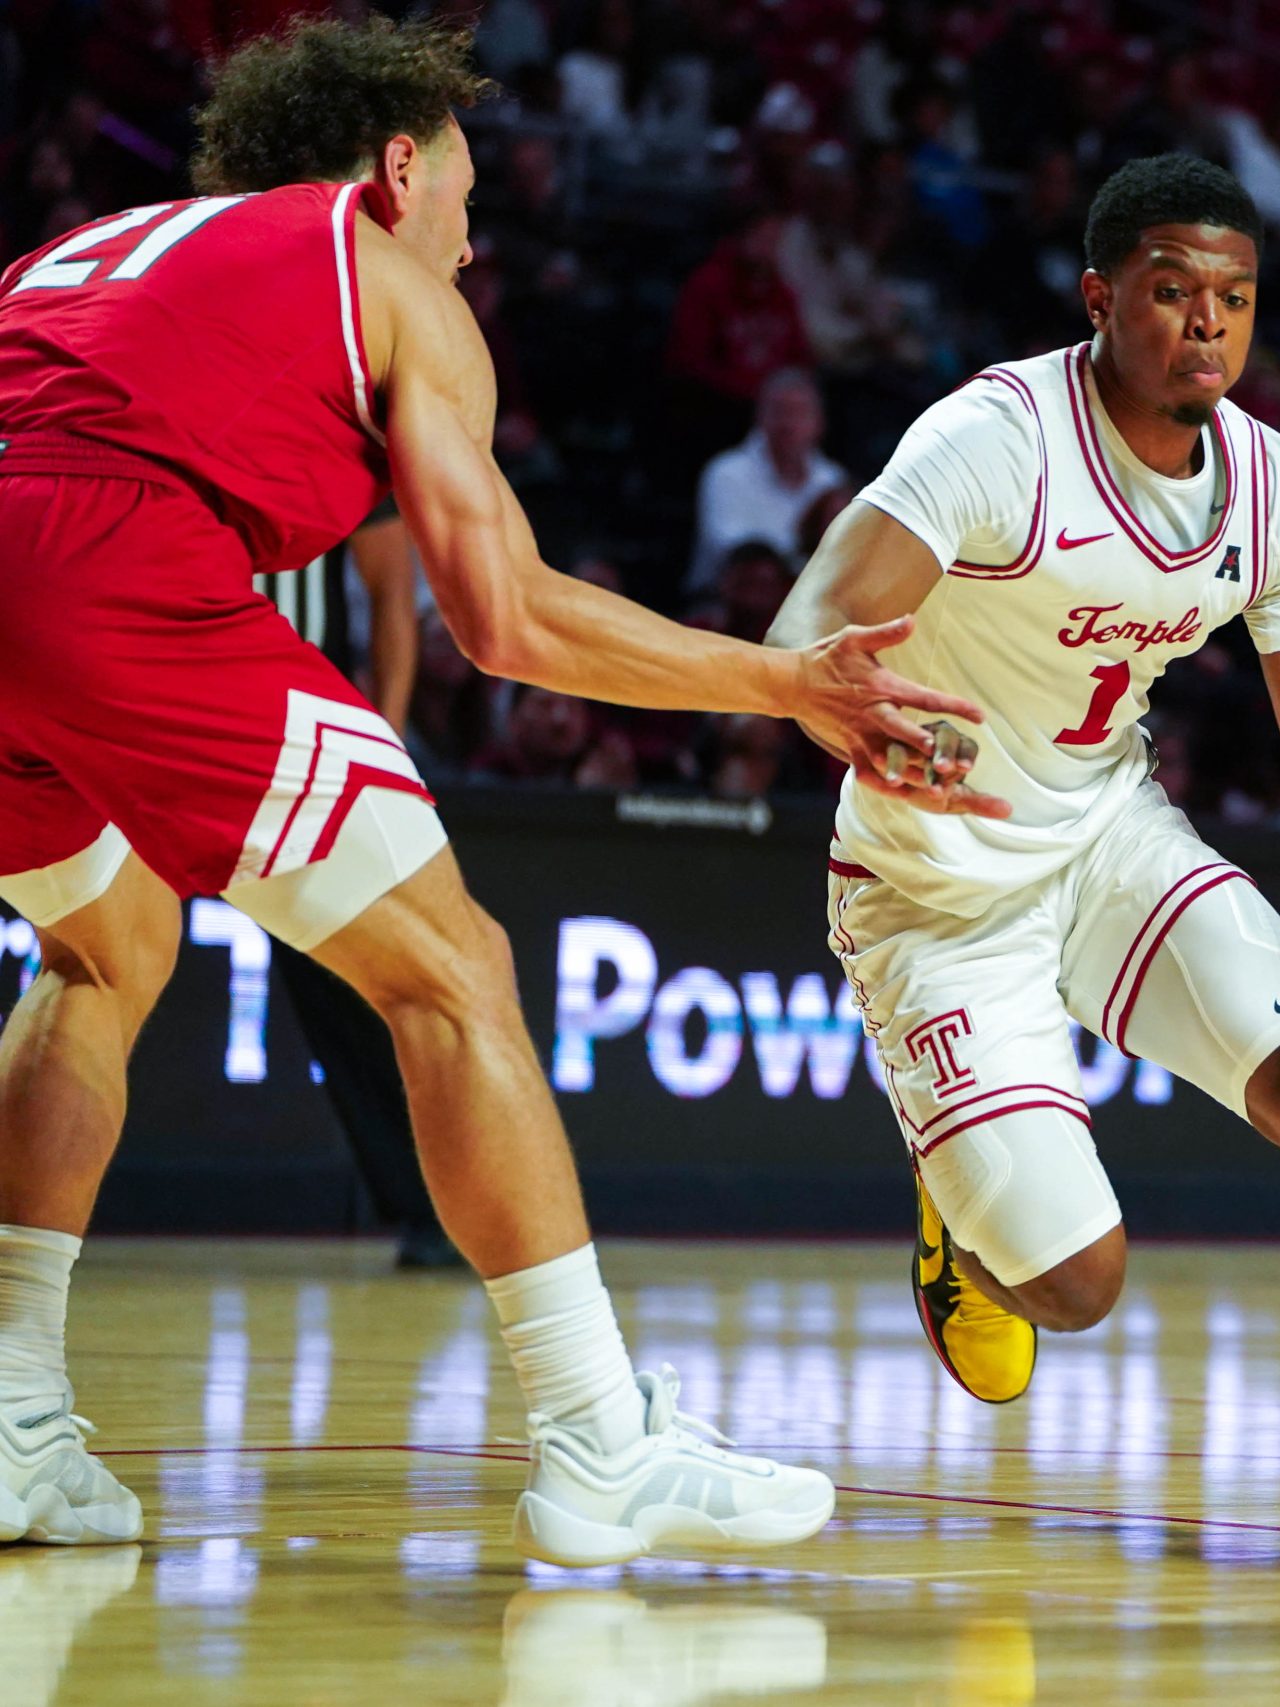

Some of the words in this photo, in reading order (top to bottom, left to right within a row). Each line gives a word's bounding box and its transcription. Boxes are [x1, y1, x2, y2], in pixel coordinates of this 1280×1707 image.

[8, 195, 247, 295] 21
[1057, 602, 1203, 653] Temple
[1052, 659, 1131, 746] 1
[904, 1005, 977, 1099] T
